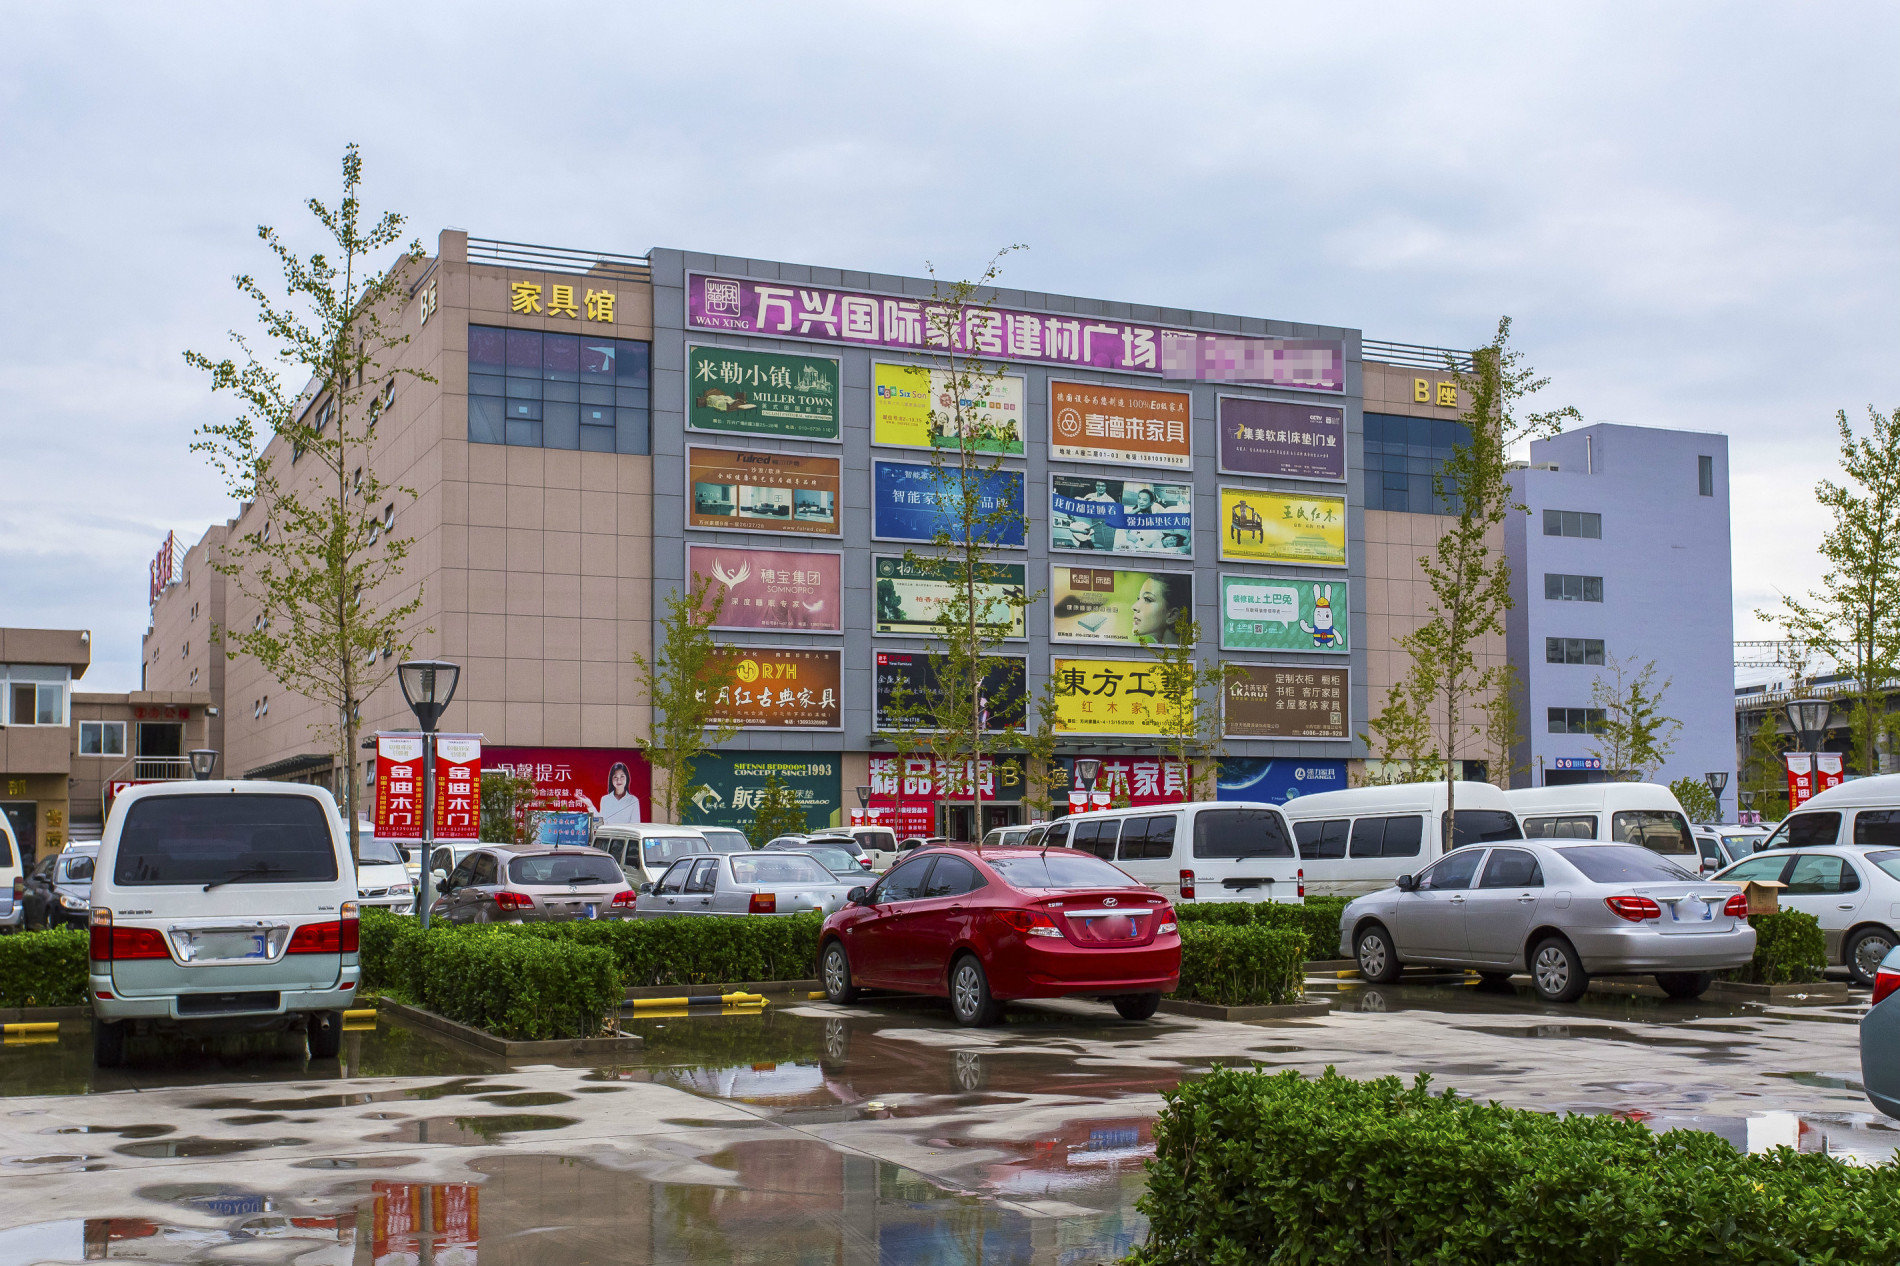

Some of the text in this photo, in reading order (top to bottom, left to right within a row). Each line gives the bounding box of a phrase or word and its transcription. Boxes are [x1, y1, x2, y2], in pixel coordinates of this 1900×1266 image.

[420, 280, 437, 325] B座
[511, 281, 615, 322] 家具馆
[696, 315, 749, 329] WAN XING
[755, 286, 1155, 368] 万兴国际家居建材广场
[695, 359, 792, 389] 米勒小镇
[753, 392, 833, 407] MILLER TOWN
[899, 389, 910, 398] Six
[912, 391, 927, 399] Son
[1414, 378, 1457, 407] B座
[1085, 414, 1185, 443] 喜德来家具
[1126, 516, 1190, 527] 强力床垫长大的
[1282, 505, 1337, 522] 王氏红木
[760, 568, 821, 586] 穗宝集团
[767, 585, 814, 595] SOMNOPRO
[731, 597, 800, 608] 深度睡眠专家
[762, 663, 797, 679] RYH
[1275, 674, 1341, 686] 定制衣柜 橱柜
[1275, 686, 1340, 698] 书柜 客厅家居
[1082, 700, 1166, 715] 红木家具
[1275, 699, 1340, 711] 全屋整体家具
[807, 764, 832, 776] 1993
[869, 759, 993, 796] 精品家具
[1001, 766, 1069, 787] B 座
[389, 765, 413, 825] 金迪木门
[447, 766, 471, 826] 金迪木门
